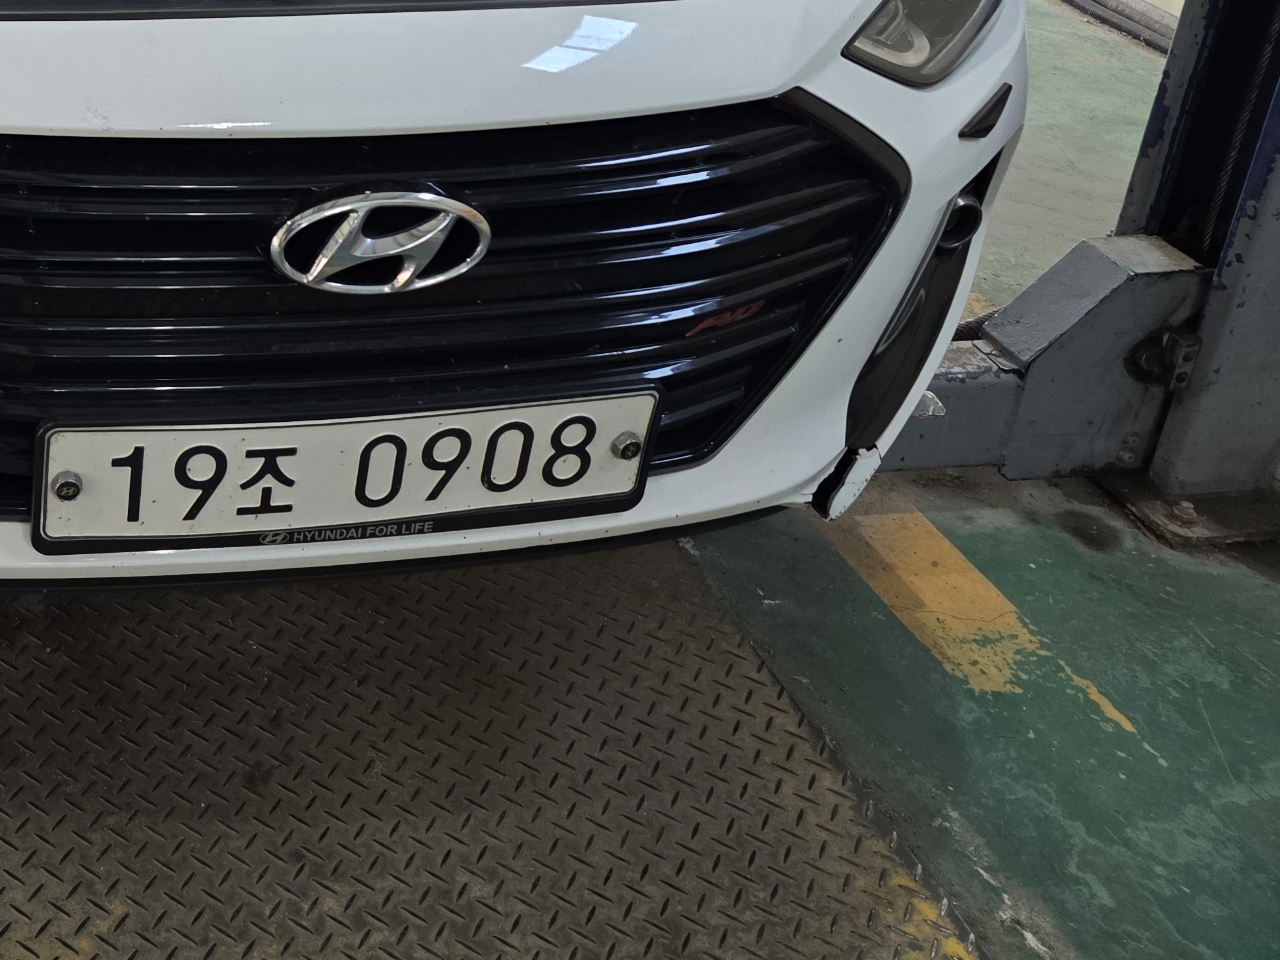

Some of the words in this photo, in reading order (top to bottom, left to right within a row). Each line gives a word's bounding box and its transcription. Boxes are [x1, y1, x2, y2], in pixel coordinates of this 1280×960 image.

[110, 444, 299, 523] 19조
[354, 415, 598, 509] 0908
[293, 527, 363, 542] HYUNDAI
[366, 524, 398, 538] FOR
[402, 521, 435, 536] LIFE
